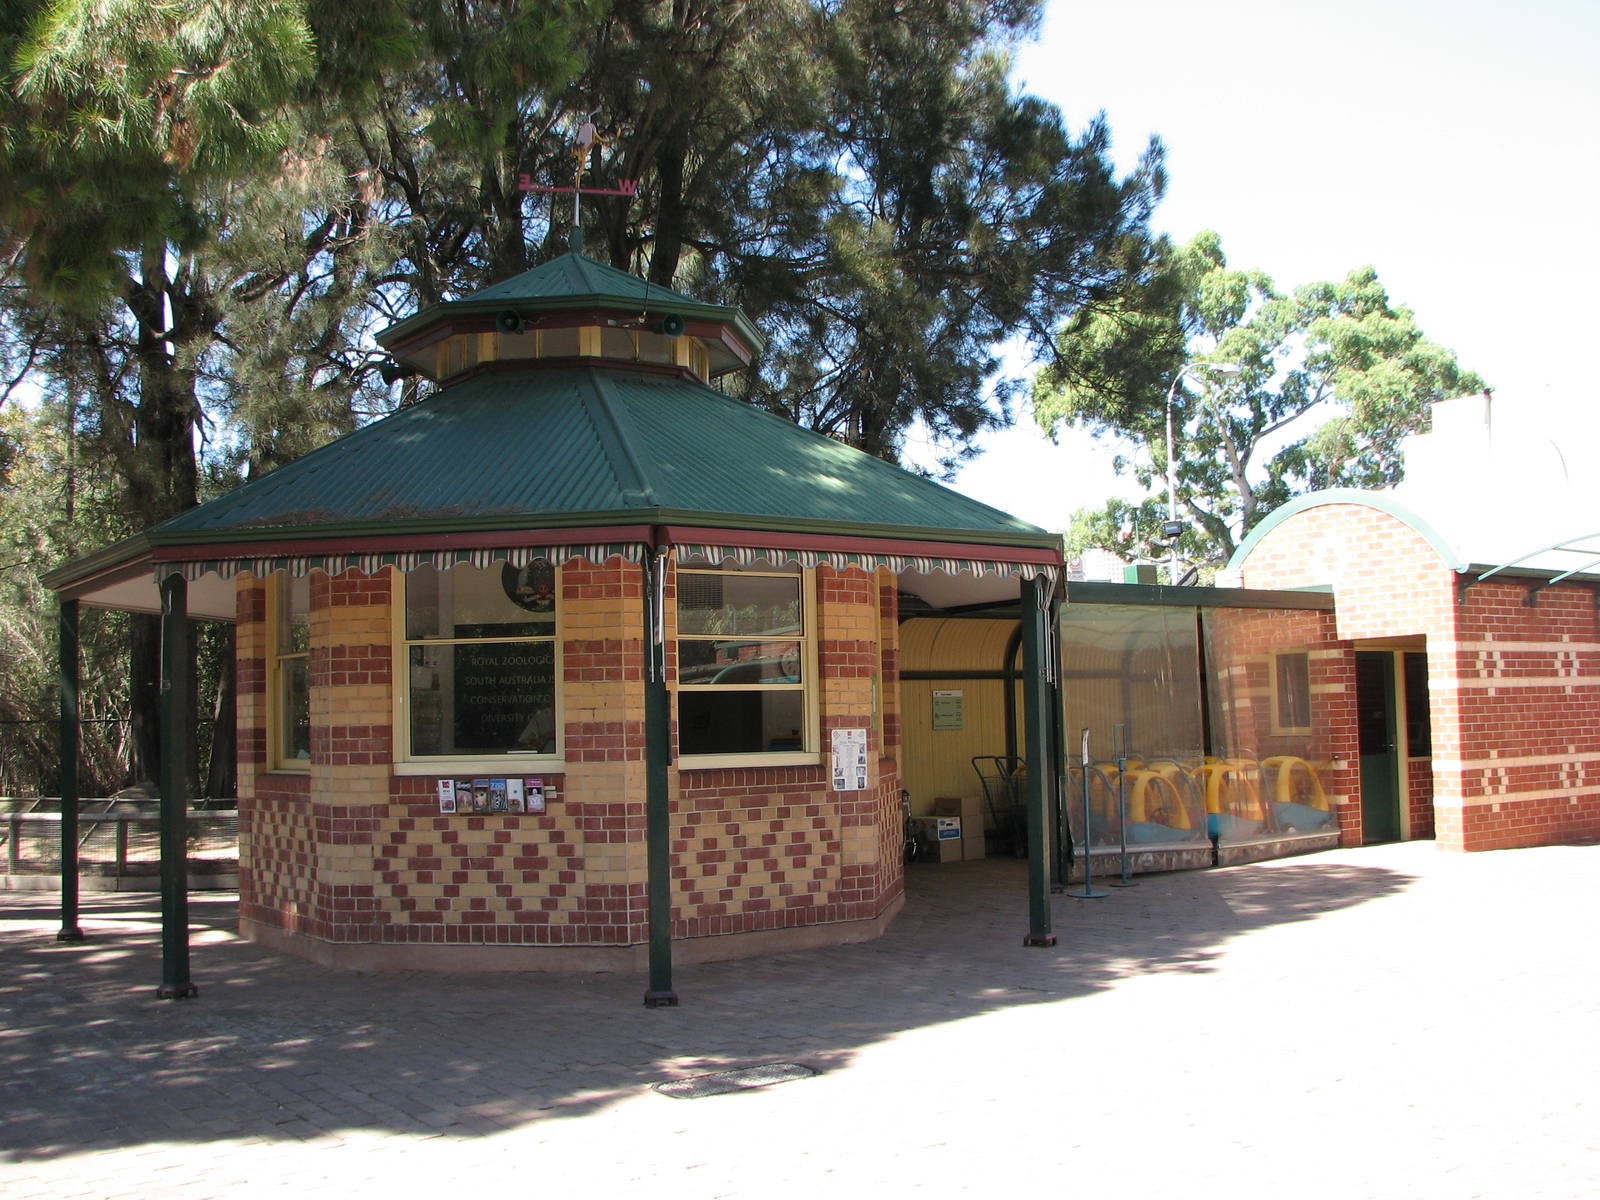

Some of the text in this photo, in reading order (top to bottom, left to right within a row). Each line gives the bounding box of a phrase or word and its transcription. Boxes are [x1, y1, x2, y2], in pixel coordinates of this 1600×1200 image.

[618, 179, 637, 195] W
[471, 656, 498, 666] ROYAL
[465, 676, 496, 686] SOUTH
[499, 675, 546, 685] AUSTRALIA
